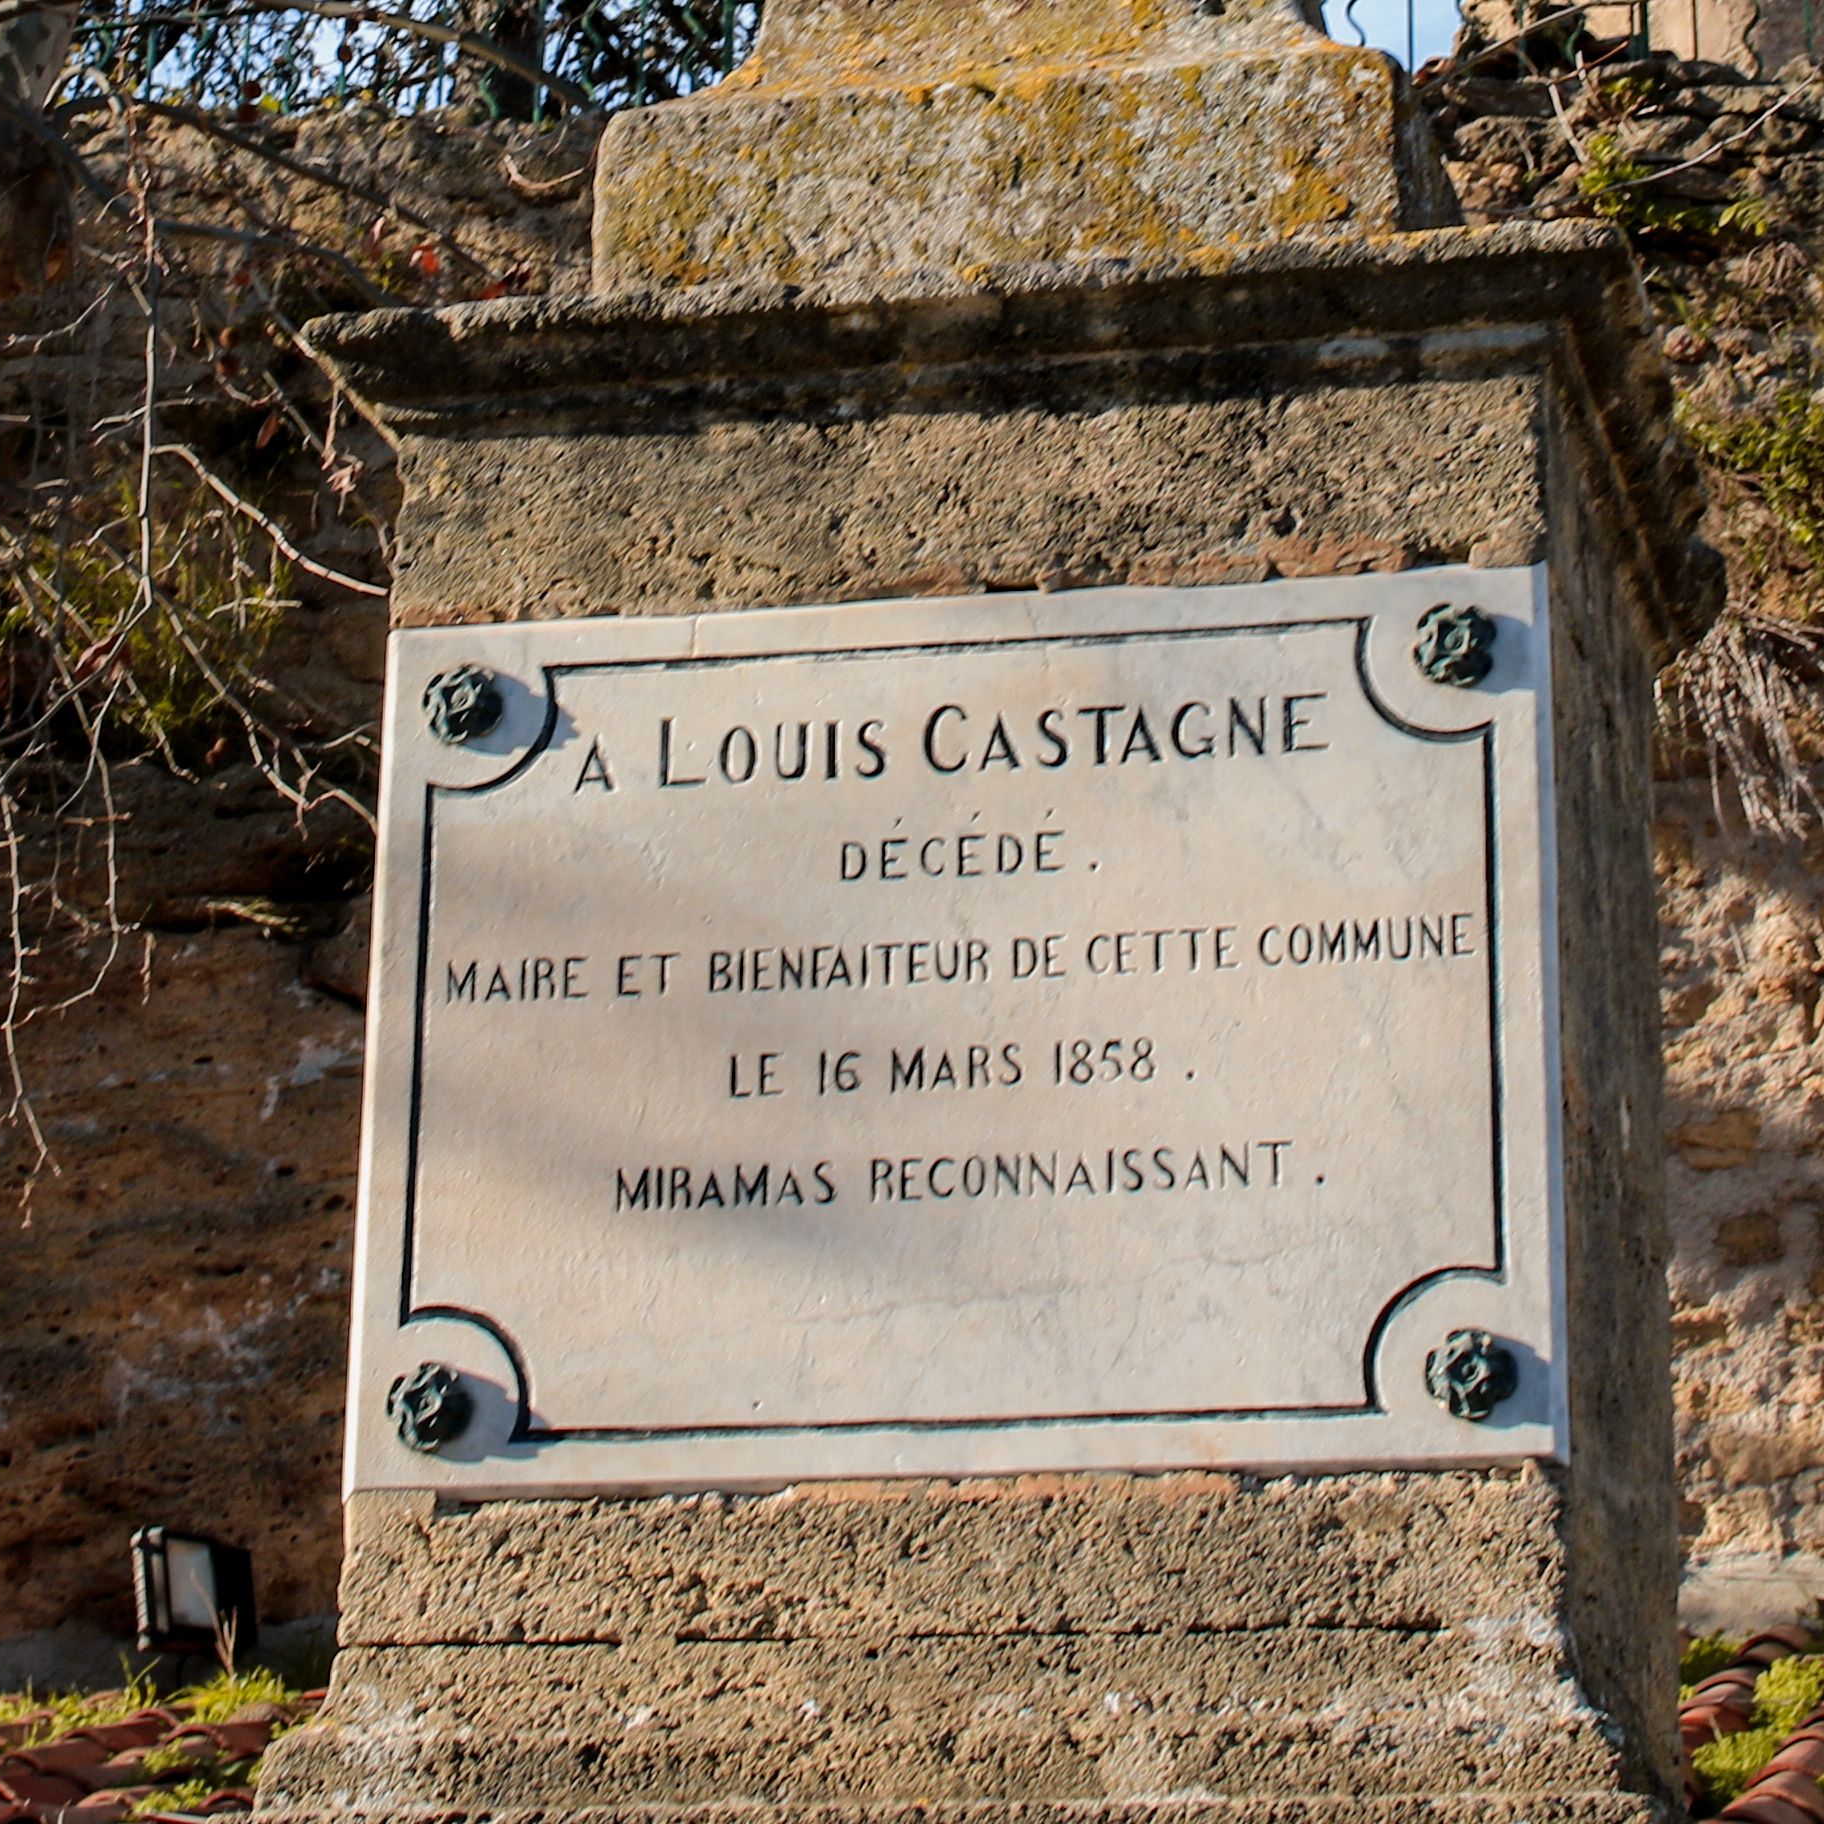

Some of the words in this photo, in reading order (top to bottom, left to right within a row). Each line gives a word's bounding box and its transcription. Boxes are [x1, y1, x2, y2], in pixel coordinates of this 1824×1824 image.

[573, 733, 618, 794] A
[658, 715, 888, 789] LOUIS
[923, 691, 1329, 774] CASTAGNE
[445, 955, 590, 1004] MAIRE
[616, 952, 681, 998] ET
[707, 939, 992, 993] BIENFAITEUR
[1012, 932, 1067, 980] DE
[1087, 925, 1241, 975] CETTE
[1258, 912, 1476, 967] COMMUNE
[728, 1052, 785, 1099] LE
[817, 1049, 862, 1096] 16
[889, 1043, 1024, 1095] MARS
[615, 1160, 837, 1213] MIRAMAS
